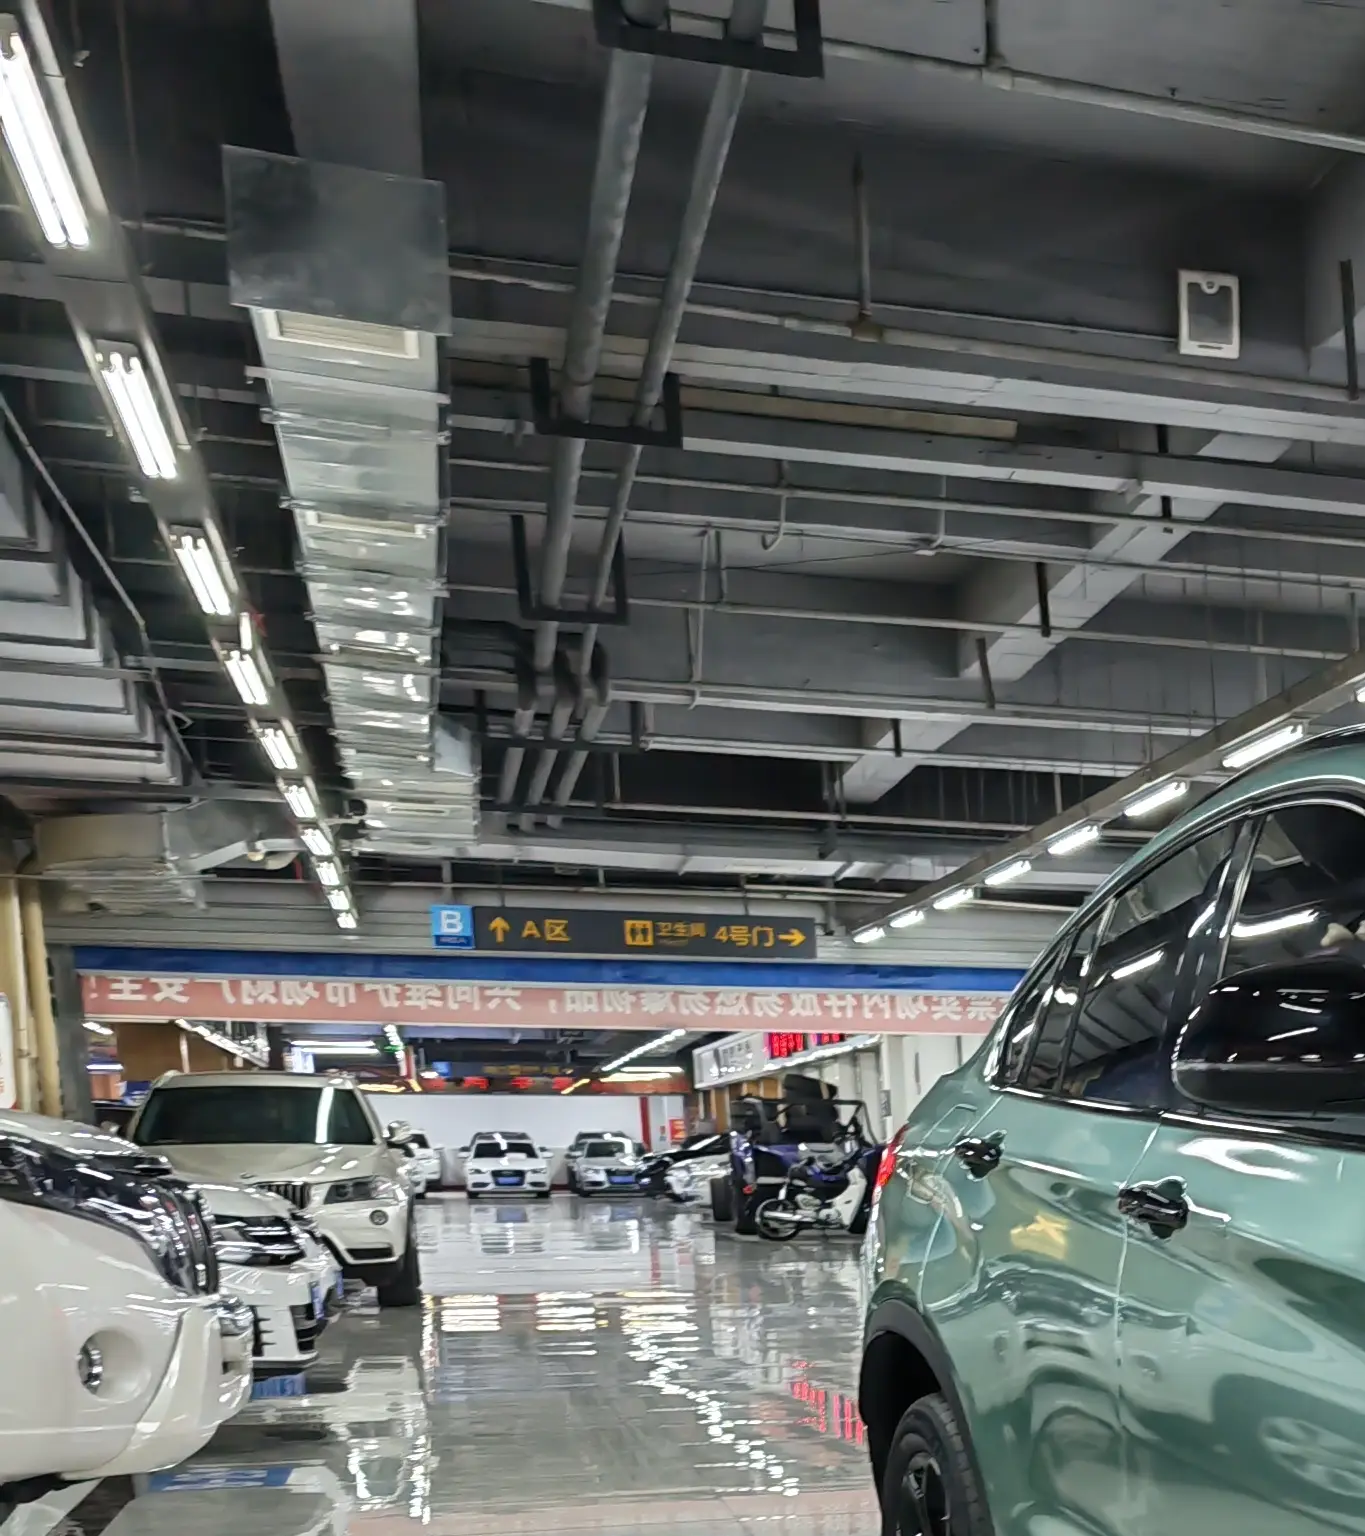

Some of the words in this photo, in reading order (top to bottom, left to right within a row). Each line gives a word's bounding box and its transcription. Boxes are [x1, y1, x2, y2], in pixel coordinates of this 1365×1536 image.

[440, 910, 463, 934] B
[521, 918, 571, 942] A区
[714, 925, 775, 947] 4号门
